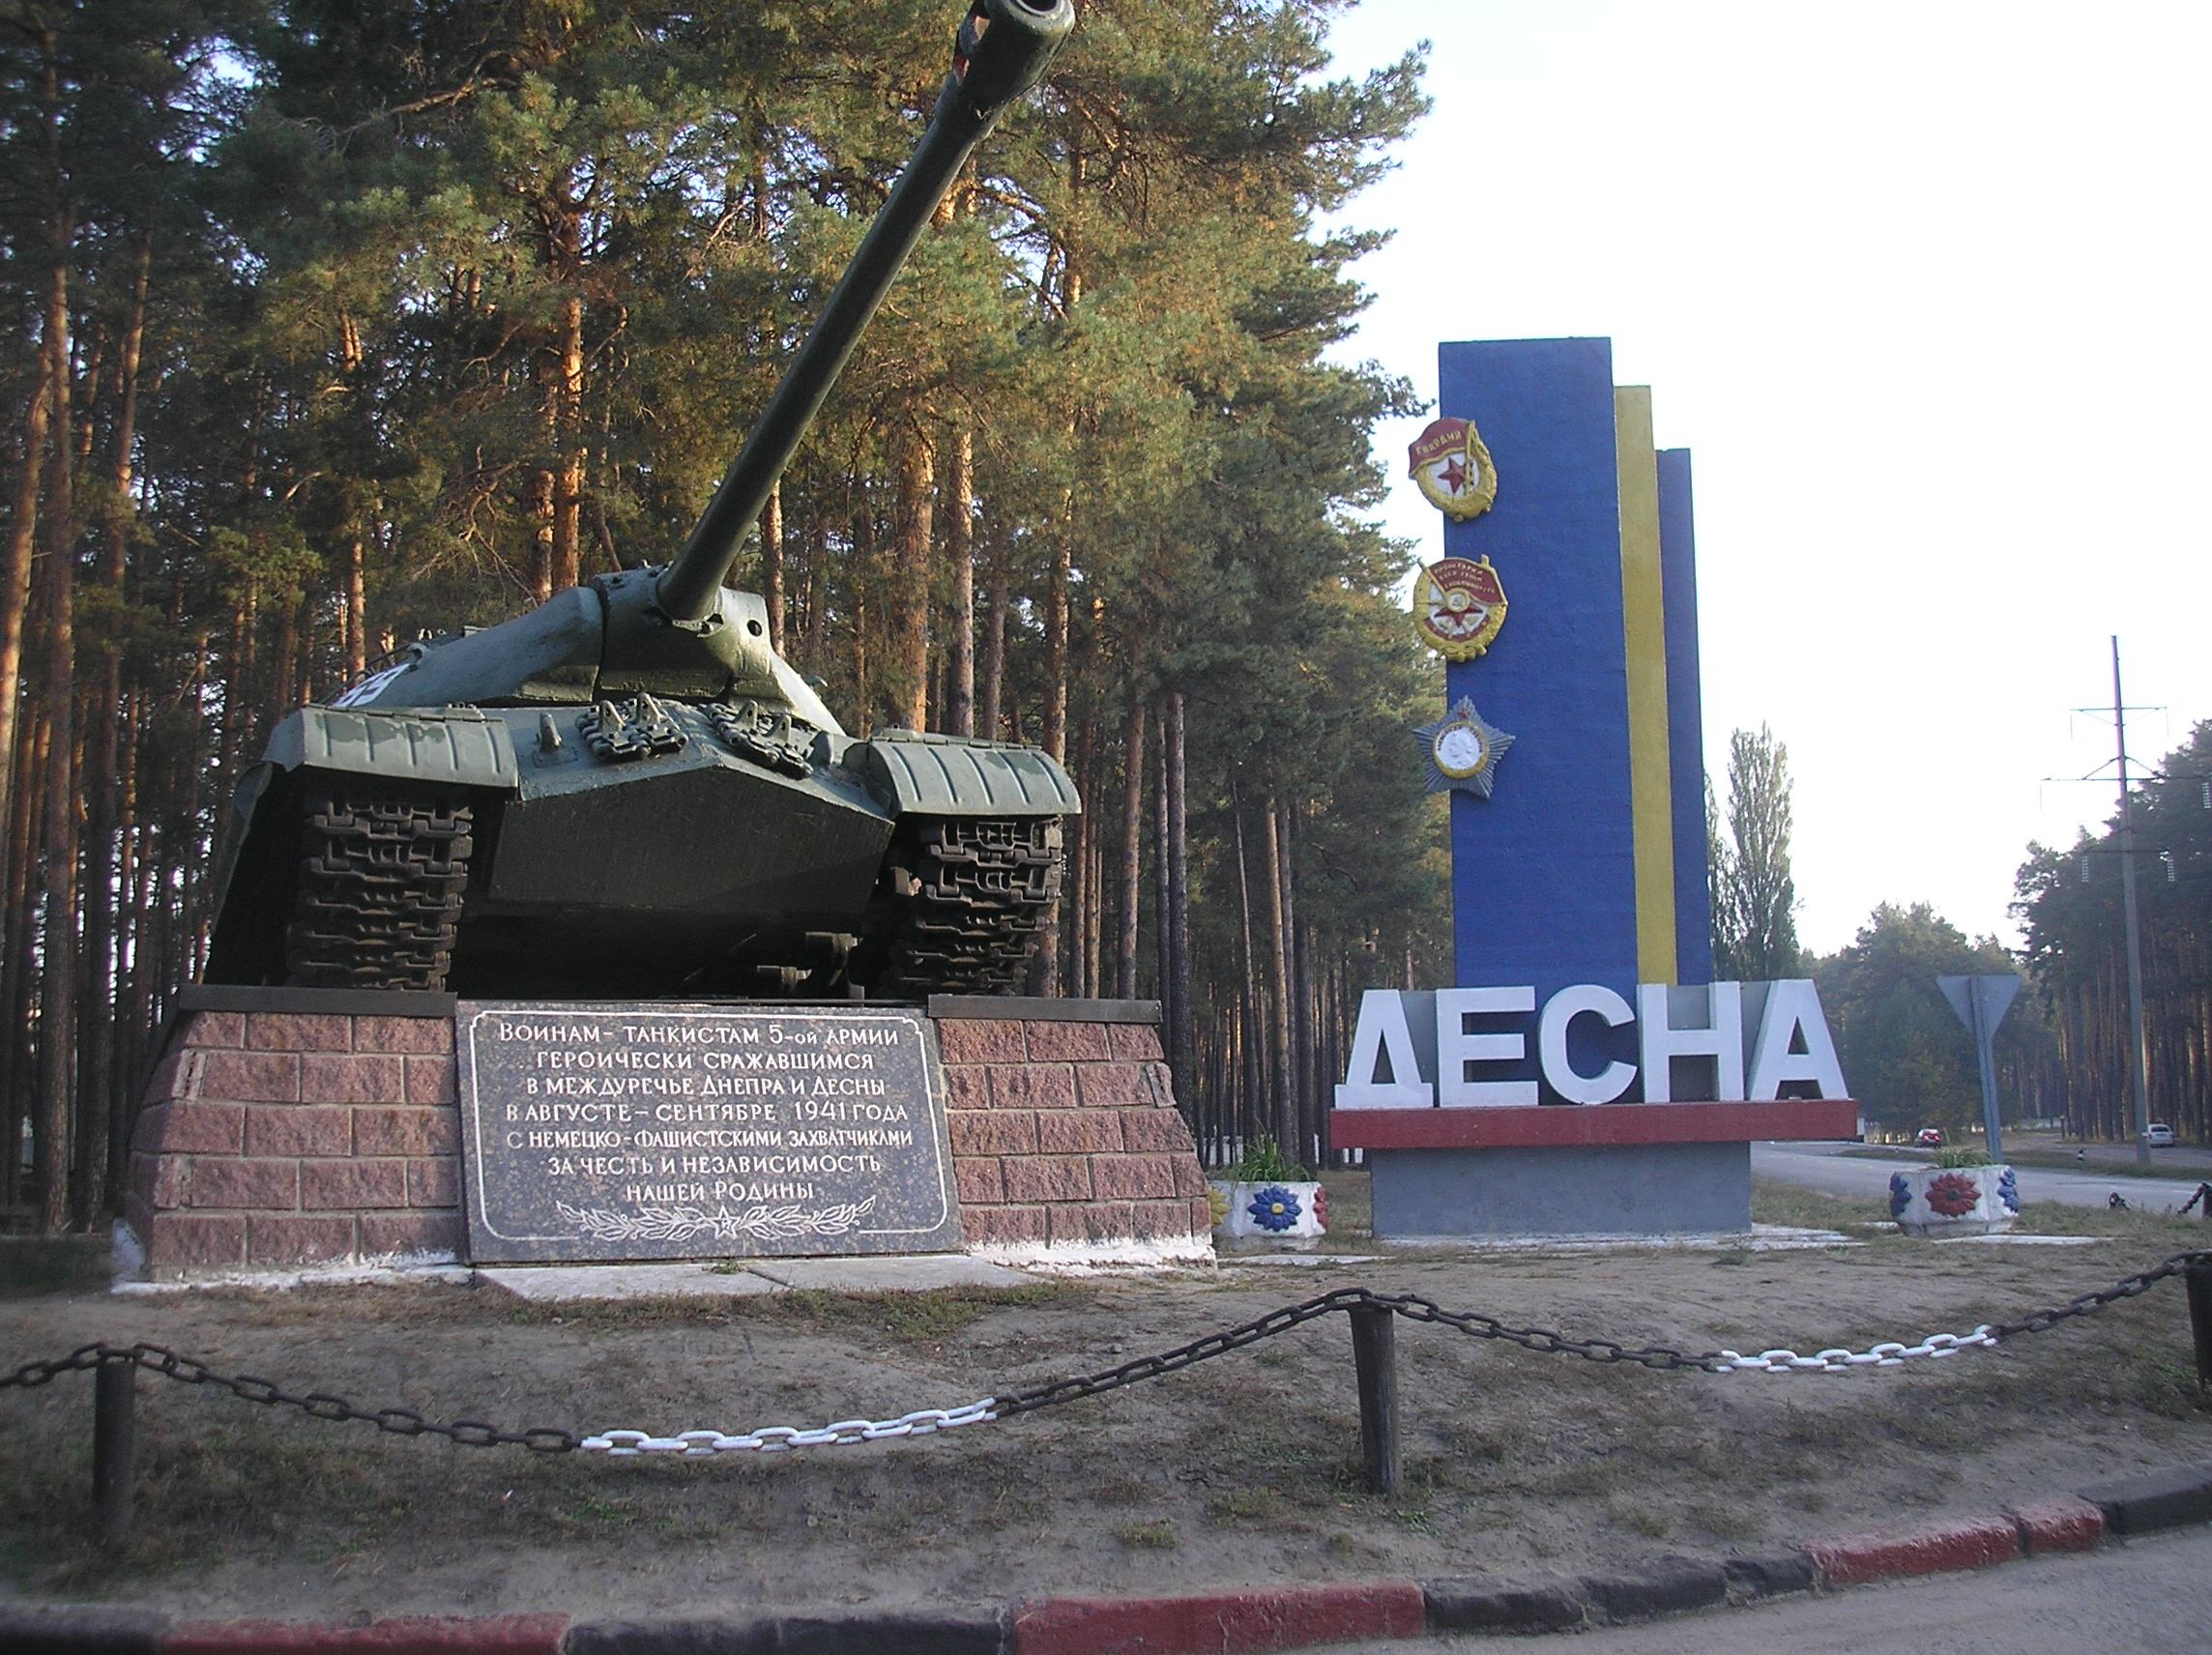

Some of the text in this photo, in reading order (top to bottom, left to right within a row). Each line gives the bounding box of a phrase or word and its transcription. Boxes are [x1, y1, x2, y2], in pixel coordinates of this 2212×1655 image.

[624, 1026, 759, 1046] ТАНКИСТАМ
[769, 1024, 818, 1044] 5-ой
[826, 1028, 898, 1046] АРМИИ
[1335, 978, 1849, 1108] ДЕСНА
[537, 1051, 874, 1070] ГЕРОИЧЕСКИ СРАЖАВШИМСЯ
[527, 1075, 886, 1097] В МЕЖДУРЕЧЬЕ ДНЕПРА И ДЕСНЫ
[507, 1104, 518, 1121] В
[655, 1104, 776, 1121] СЕНТЯБРЕ
[794, 1101, 846, 1121] 1941
[853, 1104, 908, 1122] ГОДА
[507, 1129, 914, 1150] С НЕМЕЦКО-ФАШИСТСКИМИ ЗАХВАТЧИКАМИ
[548, 1155, 881, 1176] ЗА ЧЕСТЬ И НЕЗАВИСИМОСТЬ
[626, 1181, 813, 1203] НАШЕЙ РОДИНЫ
